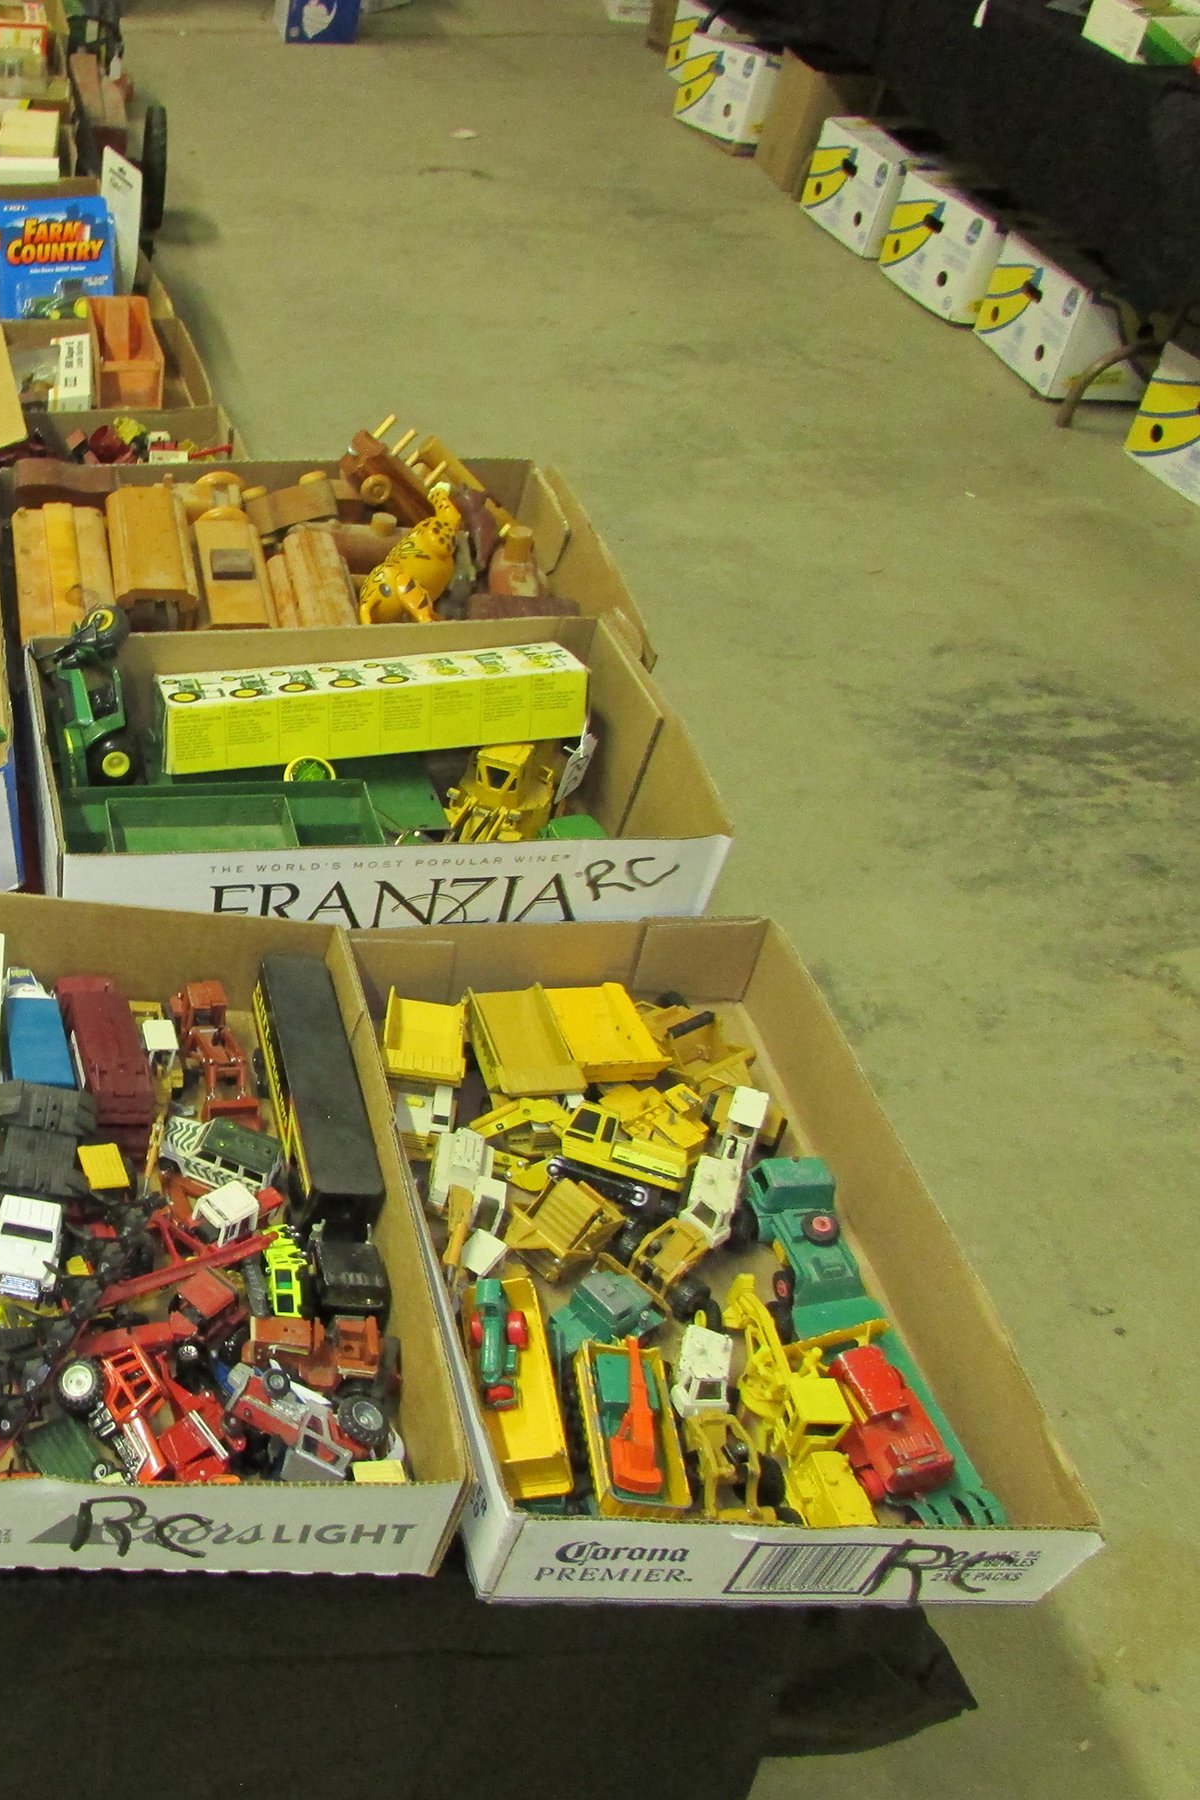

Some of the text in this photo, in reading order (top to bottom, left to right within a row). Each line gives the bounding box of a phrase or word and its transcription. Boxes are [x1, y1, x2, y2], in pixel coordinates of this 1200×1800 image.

[23, 217, 86, 244] FARM
[6, 238, 105, 267] COUNTRY
[210, 865, 244, 873] THE
[257, 862, 342, 873] WORLD'S
[353, 859, 403, 869] MOST
[415, 856, 503, 868] POPULAR
[584, 856, 680, 901] RC
[210, 872, 576, 930] FRANZIA
[69, 1495, 214, 1558] RC
[271, 1523, 419, 1545] LIGHT
[555, 1540, 690, 1566] Corona
[534, 1566, 683, 1583] PREMIER
[973, 1572, 1023, 1582] PACKS
